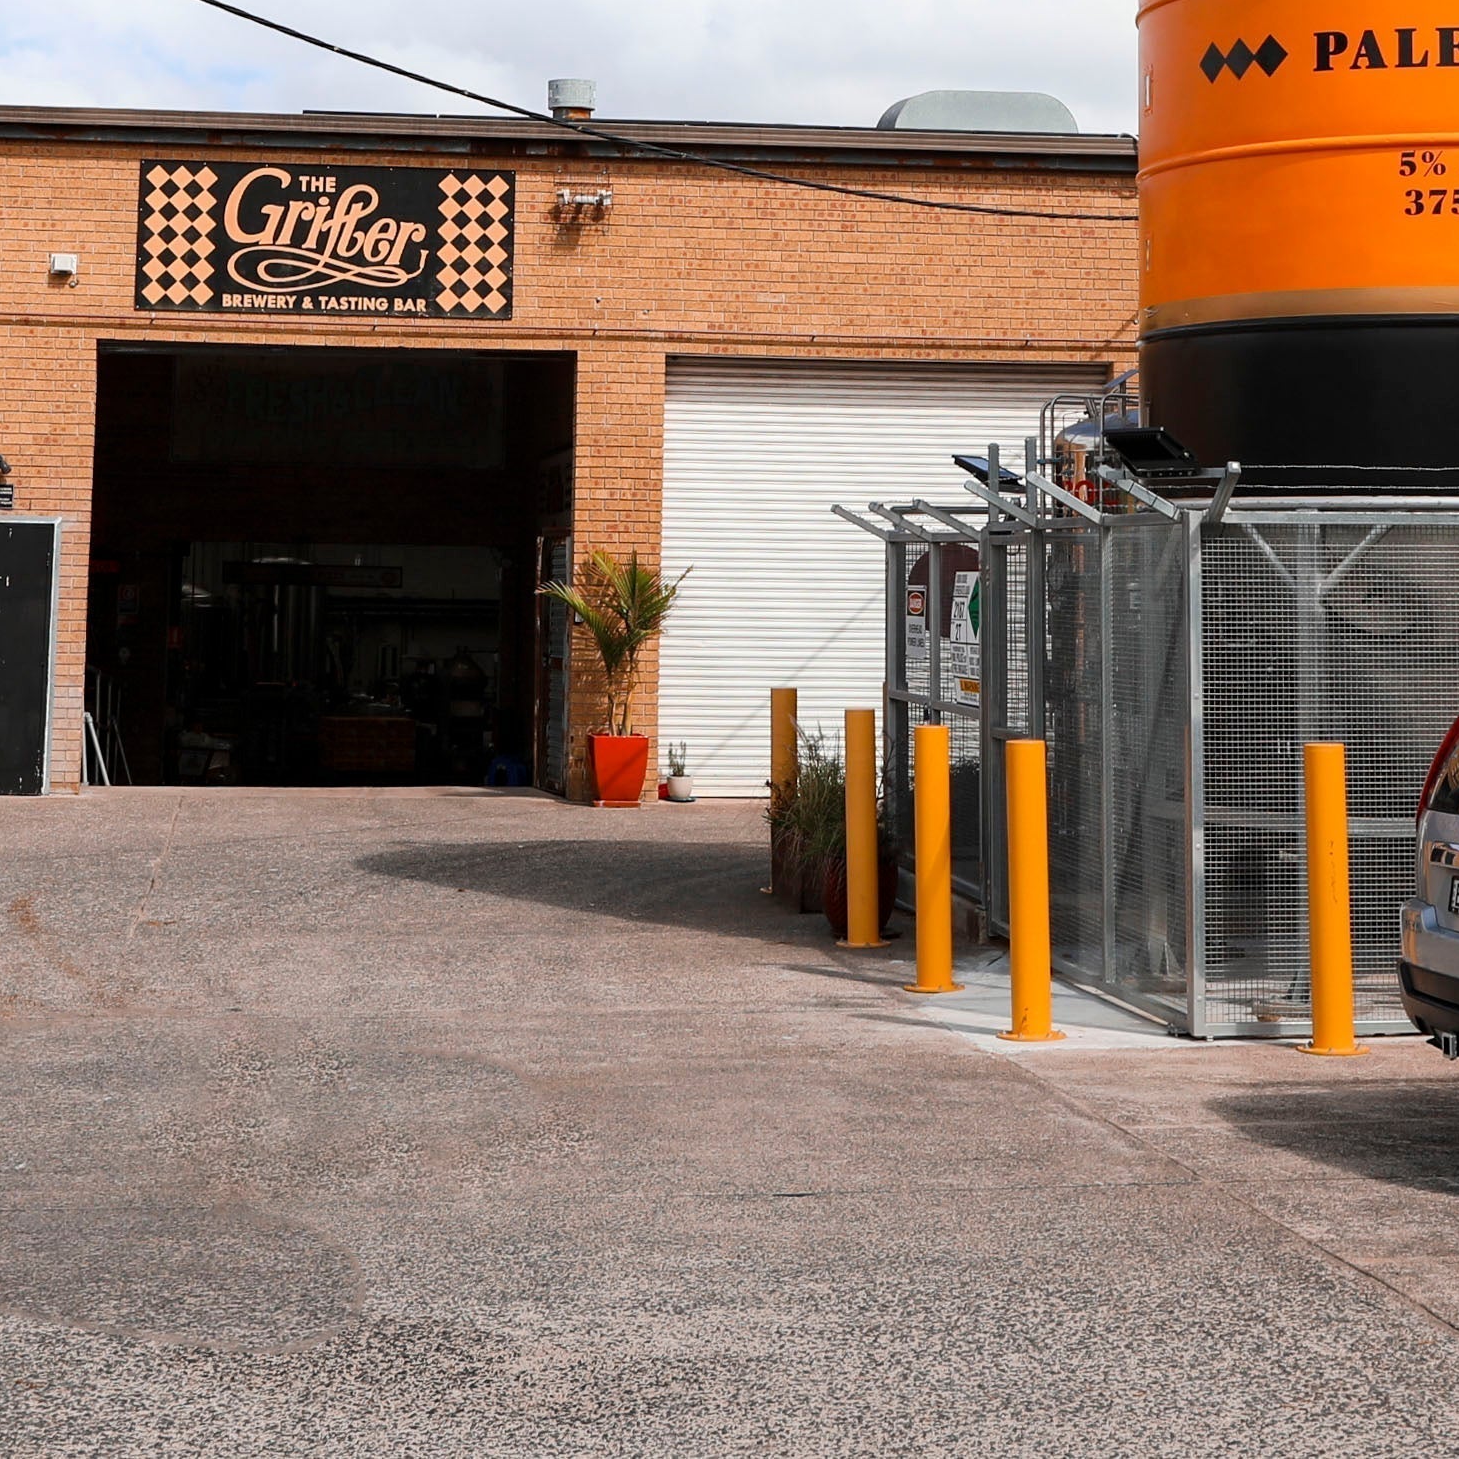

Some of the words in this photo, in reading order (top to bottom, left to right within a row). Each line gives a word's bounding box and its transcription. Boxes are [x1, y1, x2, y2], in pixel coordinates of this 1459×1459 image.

[1398, 150, 1447, 176] 5%
[298, 174, 338, 194] THE
[223, 166, 429, 293] Grifter
[221, 293, 297, 310] BREWERY
[301, 295, 315, 310] &
[318, 295, 389, 312] TASTING
[393, 297, 427, 313] BAR
